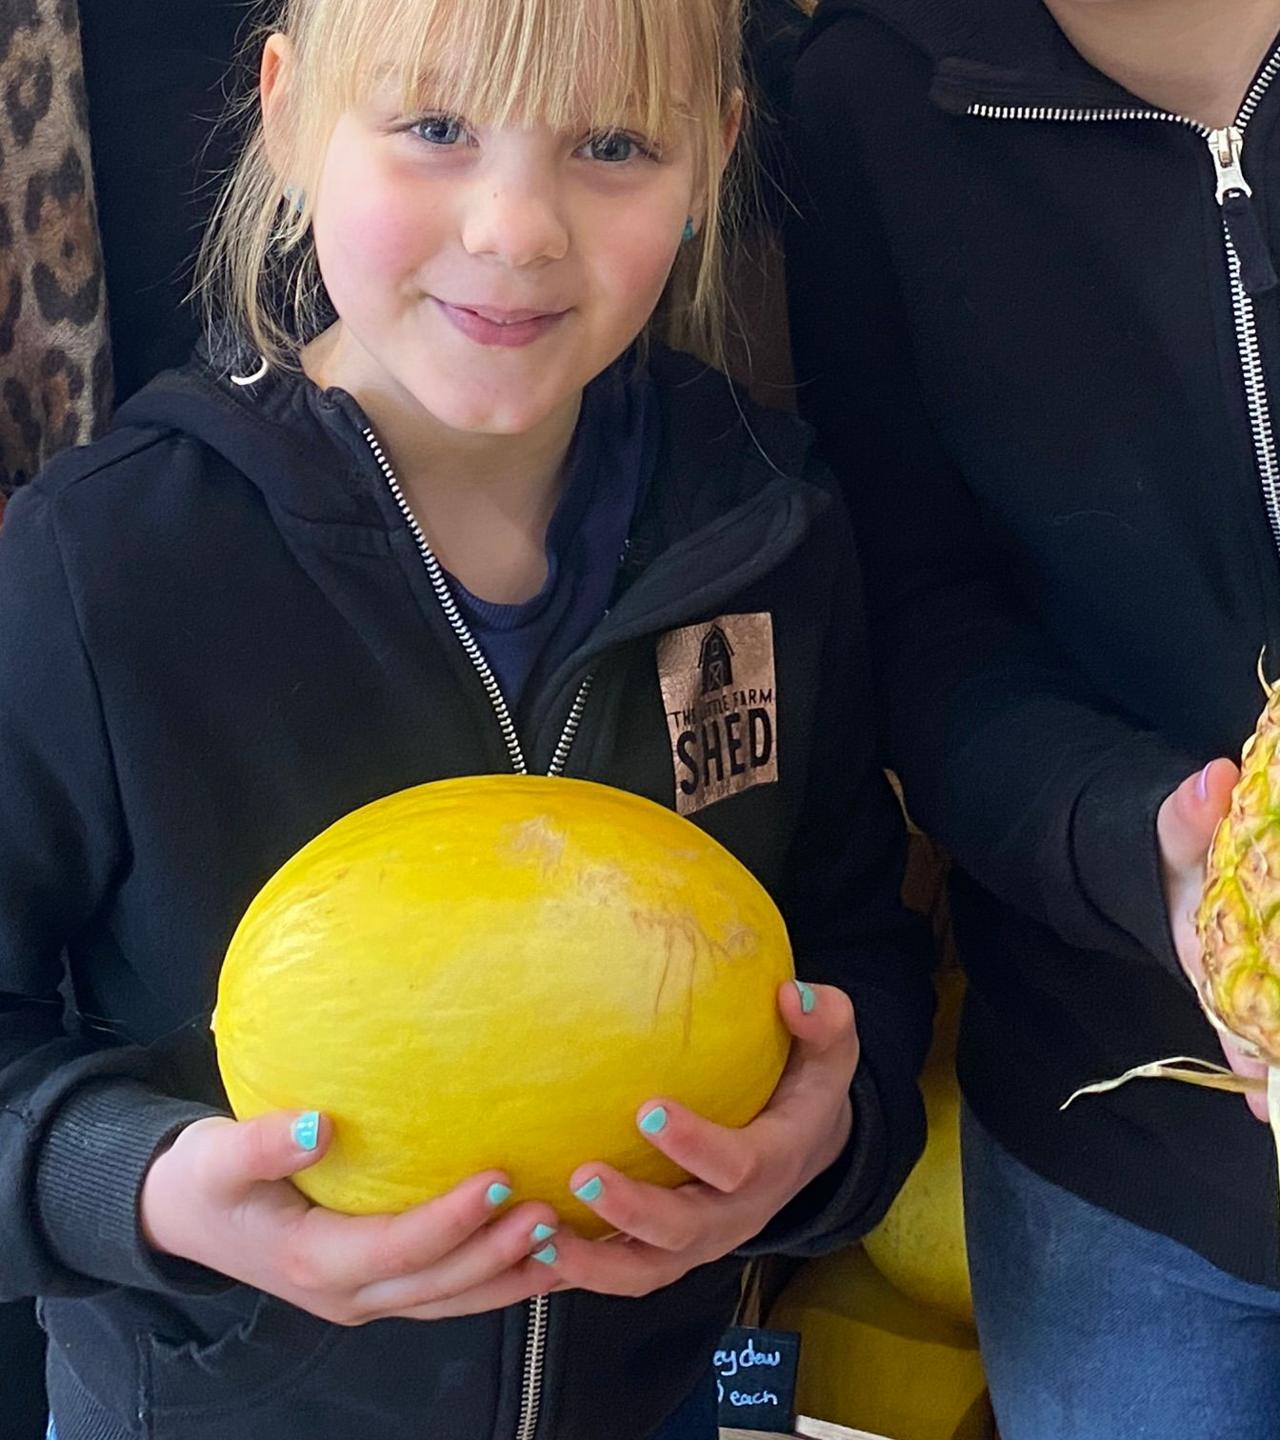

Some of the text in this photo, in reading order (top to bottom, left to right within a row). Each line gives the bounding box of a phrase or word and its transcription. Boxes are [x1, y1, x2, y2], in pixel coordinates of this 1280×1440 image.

[734, 688, 772, 707] FARM
[677, 708, 772, 795] SHED
[730, 1390, 778, 1406] each
